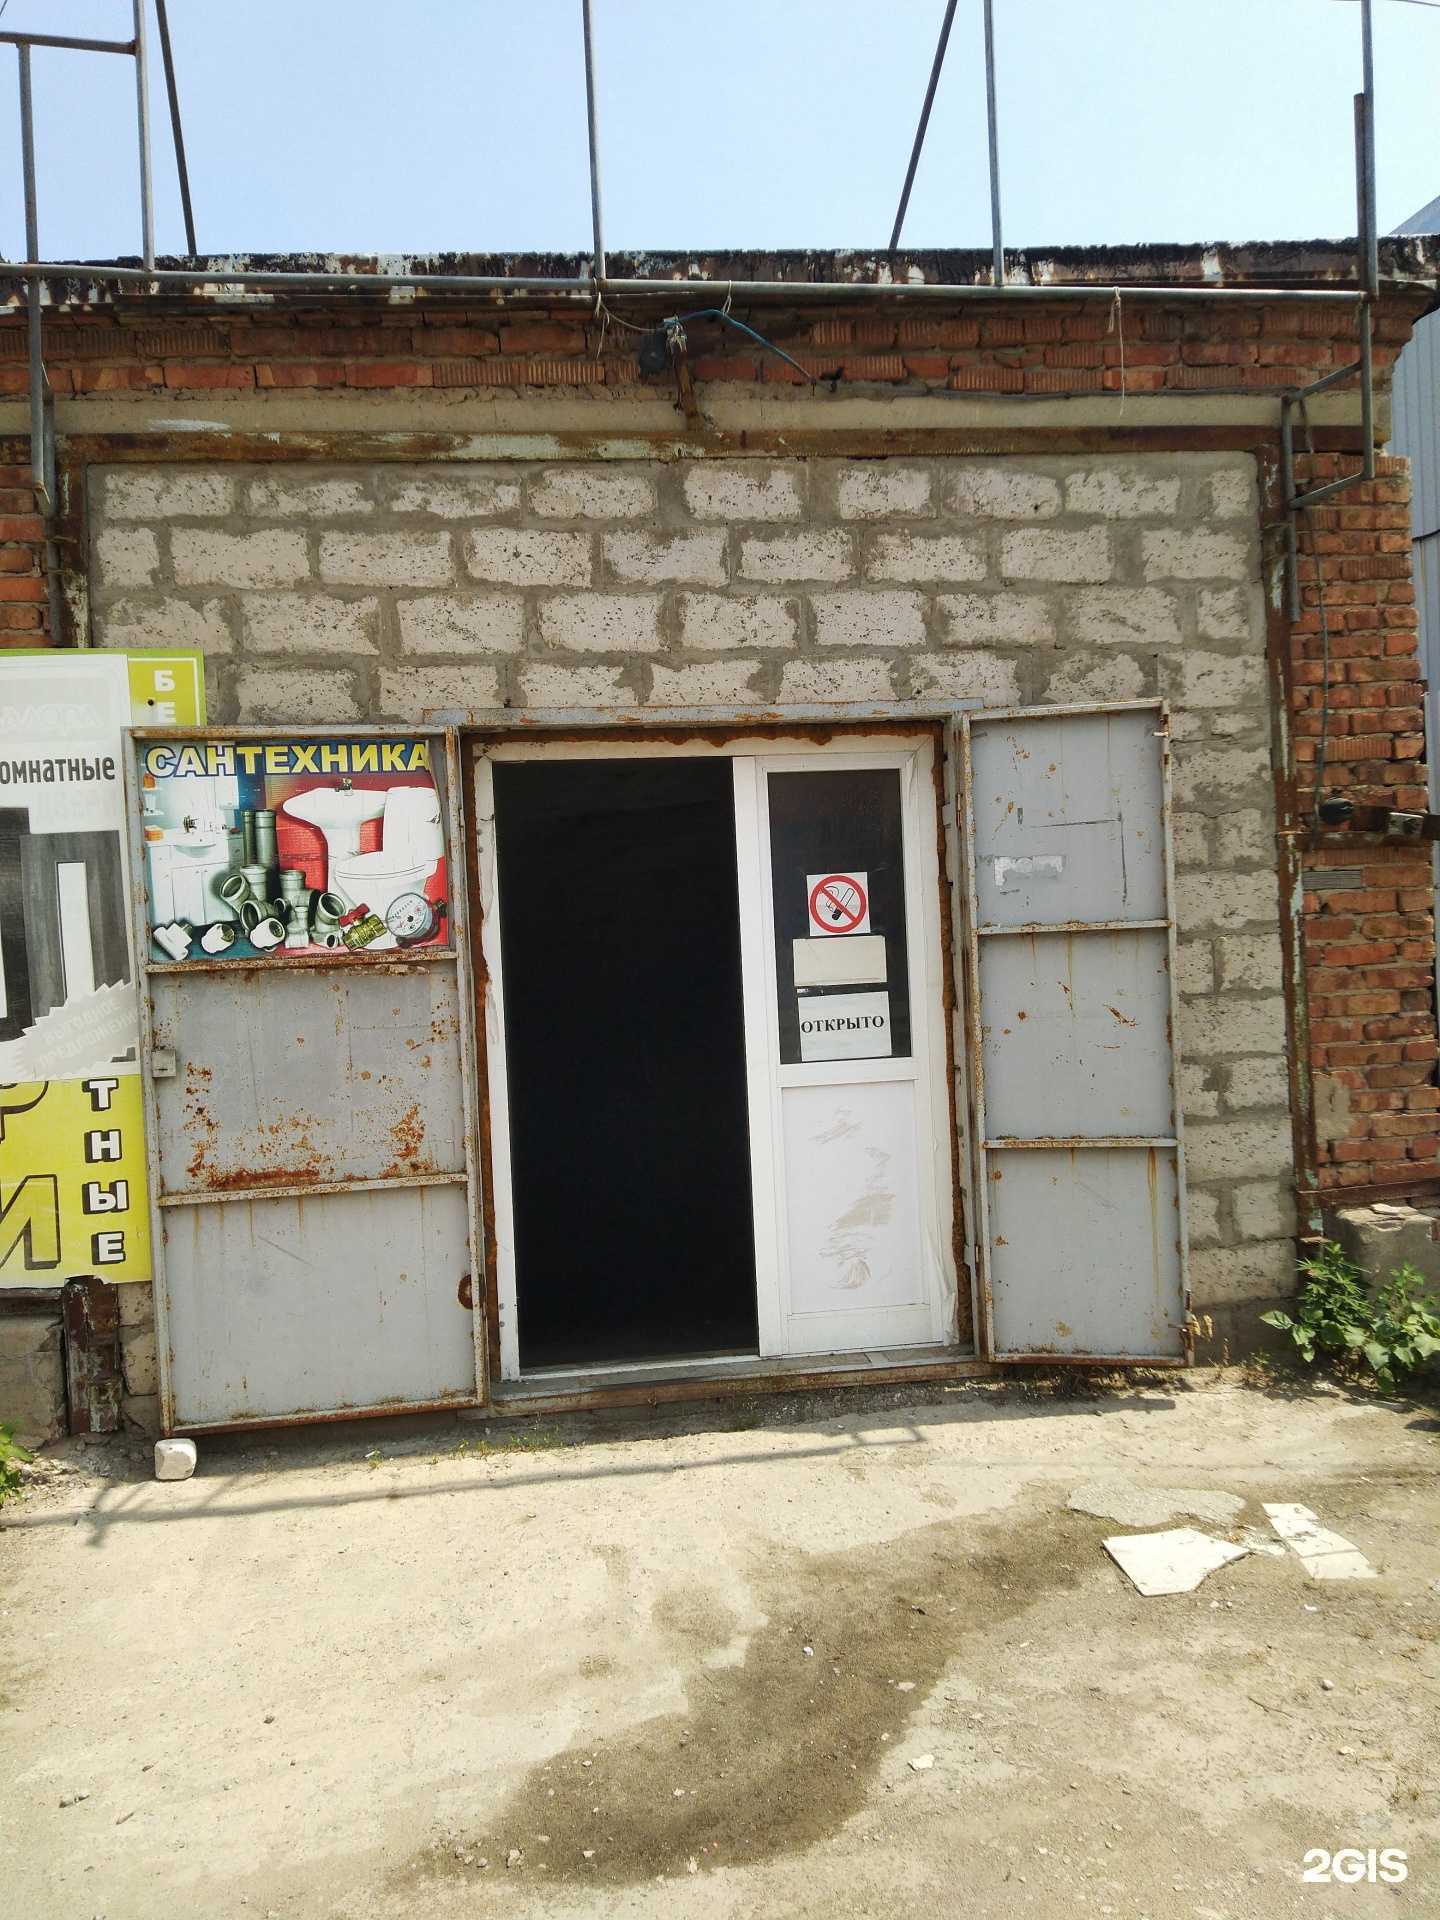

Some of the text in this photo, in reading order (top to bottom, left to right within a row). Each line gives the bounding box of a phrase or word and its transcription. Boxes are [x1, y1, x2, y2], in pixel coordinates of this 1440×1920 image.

[0, 756, 116, 785] омнатные
[145, 741, 433, 778] САНТЕХНИКА
[801, 1015, 885, 1033] ОТКРЫТО
